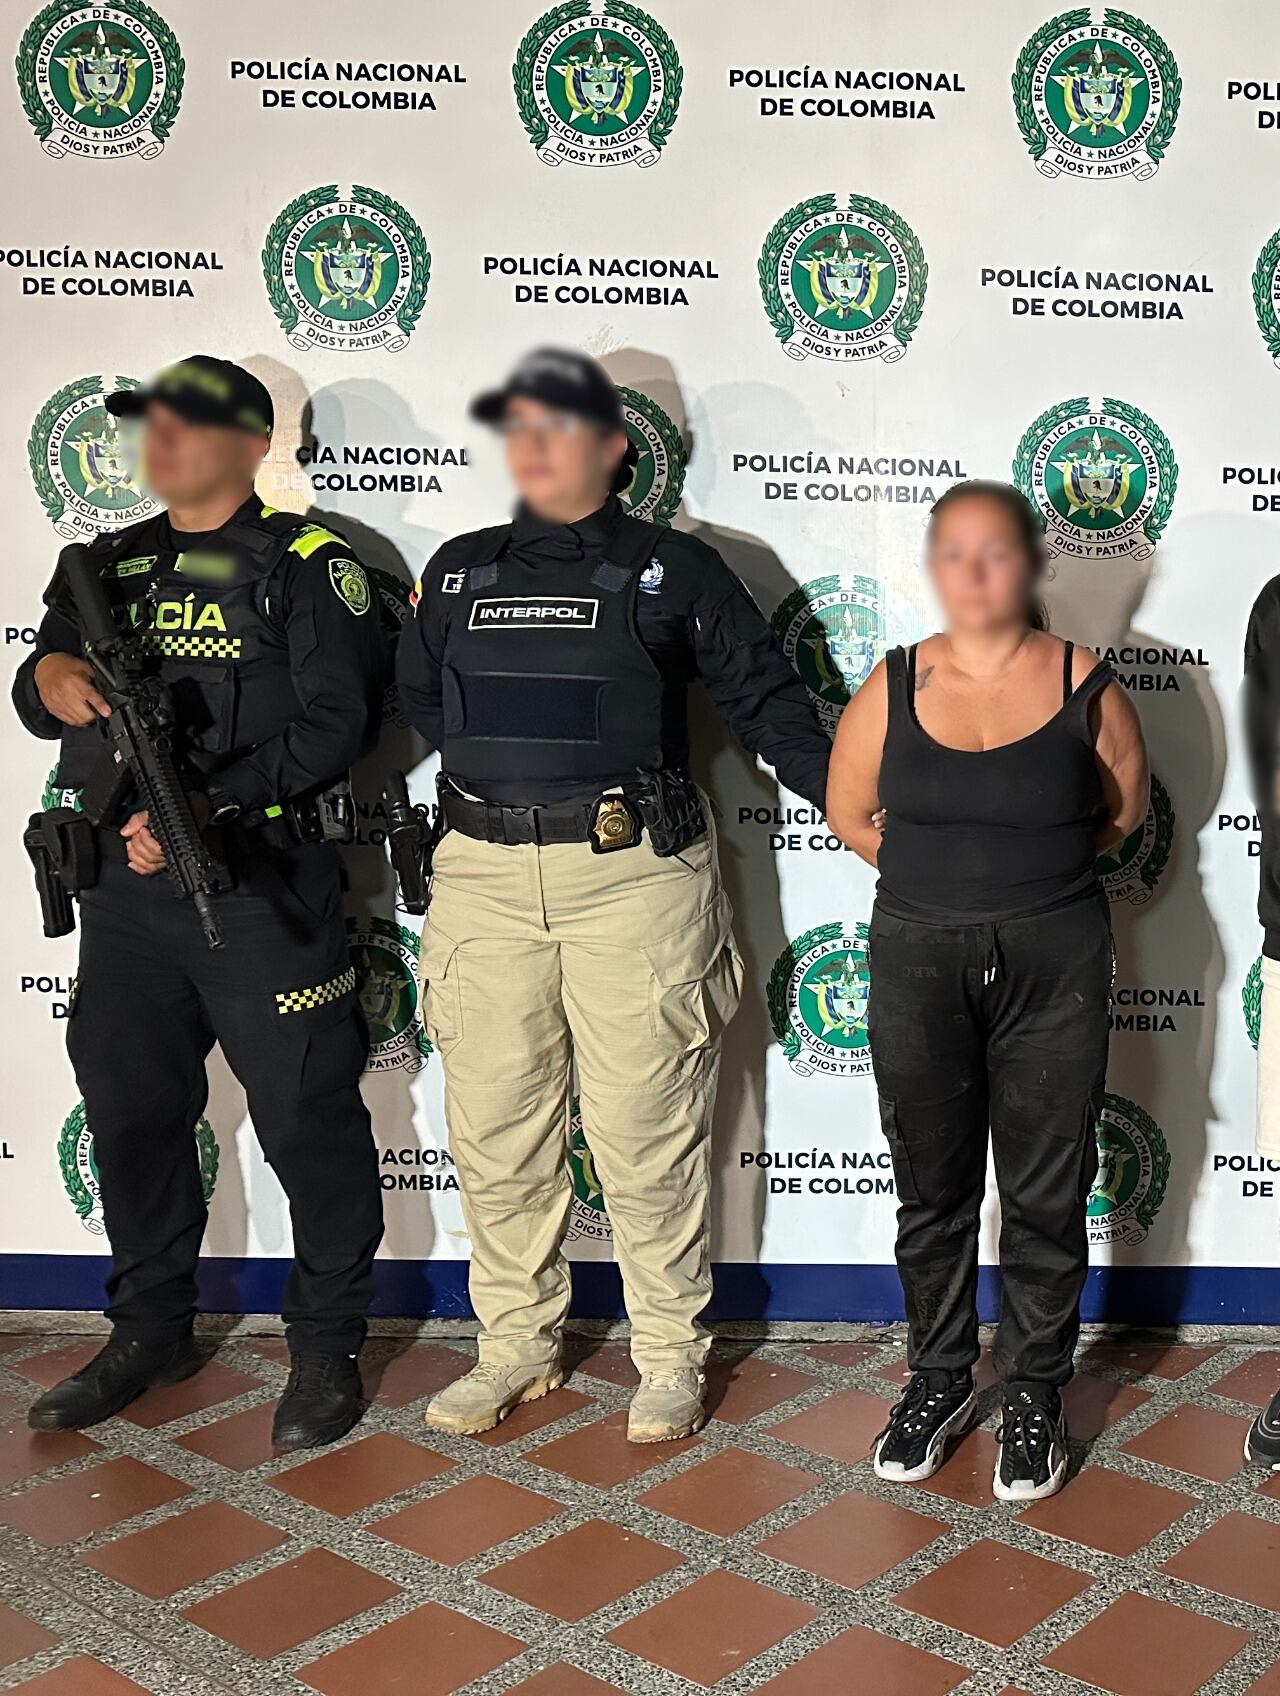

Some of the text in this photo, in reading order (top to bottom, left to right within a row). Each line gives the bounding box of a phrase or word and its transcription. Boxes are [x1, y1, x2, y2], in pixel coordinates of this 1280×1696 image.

[92, 9, 111, 20] DE
[123, 17, 165, 85] COLOMBIA
[230, 56, 467, 83] POLICÍA NACIONAL
[1090, 27, 1109, 38] DE
[1121, 35, 1161, 105] COLOMBIA
[729, 64, 966, 92] POLICÍA NACIONAL
[262, 89, 437, 111] DE COLOMBIA
[760, 97, 936, 120] DE COLOMBIA
[102, 97, 160, 137] NACIONAL
[102, 136, 147, 155] PATRIA
[1097, 117, 1156, 157] NACIONAL
[1096, 156, 1141, 176] PATRIA
[94, 250, 224, 270] NACIONAL
[835, 212, 854, 224] DE
[867, 220, 908, 289] COLOMBIA
[483, 252, 719, 279] POLICÍA NACIONAL
[22, 276, 195, 298] DE COLOMBIA
[981, 265, 1214, 293] POLICÍA NACIONAL
[515, 284, 690, 306] DE COLOMBIA
[1012, 297, 1185, 320] DE COLOMBIA
[844, 301, 903, 340] NACIONAL
[844, 339, 889, 359] PATRIA
[625, 410, 667, 477] COLOMBIA
[1088, 415, 1107, 426] DE
[1119, 423, 1158, 490] COLOMBIA
[732, 450, 967, 478] POLICÍA NACIONAL
[310, 473, 443, 493] COLOMBIA
[764, 481, 937, 504] DE COLOMBIA
[1096, 501, 1153, 539] NACIONAL
[1095, 538, 1139, 557] PATRIA
[479, 607, 586, 619] INTERPOL
[1118, 673, 1180, 692] MBIA
[769, 833, 802, 851] DE
[1113, 1115, 1151, 1178] COLOMBIA
[739, 1147, 836, 1170] POLICÍA
[379, 1173, 460, 1191] OMBIA
[769, 1177, 895, 1195] DE COLOM
[1242, 1180, 1274, 1198] DE
[1090, 1188, 1146, 1225] NACIONAL
[1089, 1224, 1131, 1242] PATRIA
